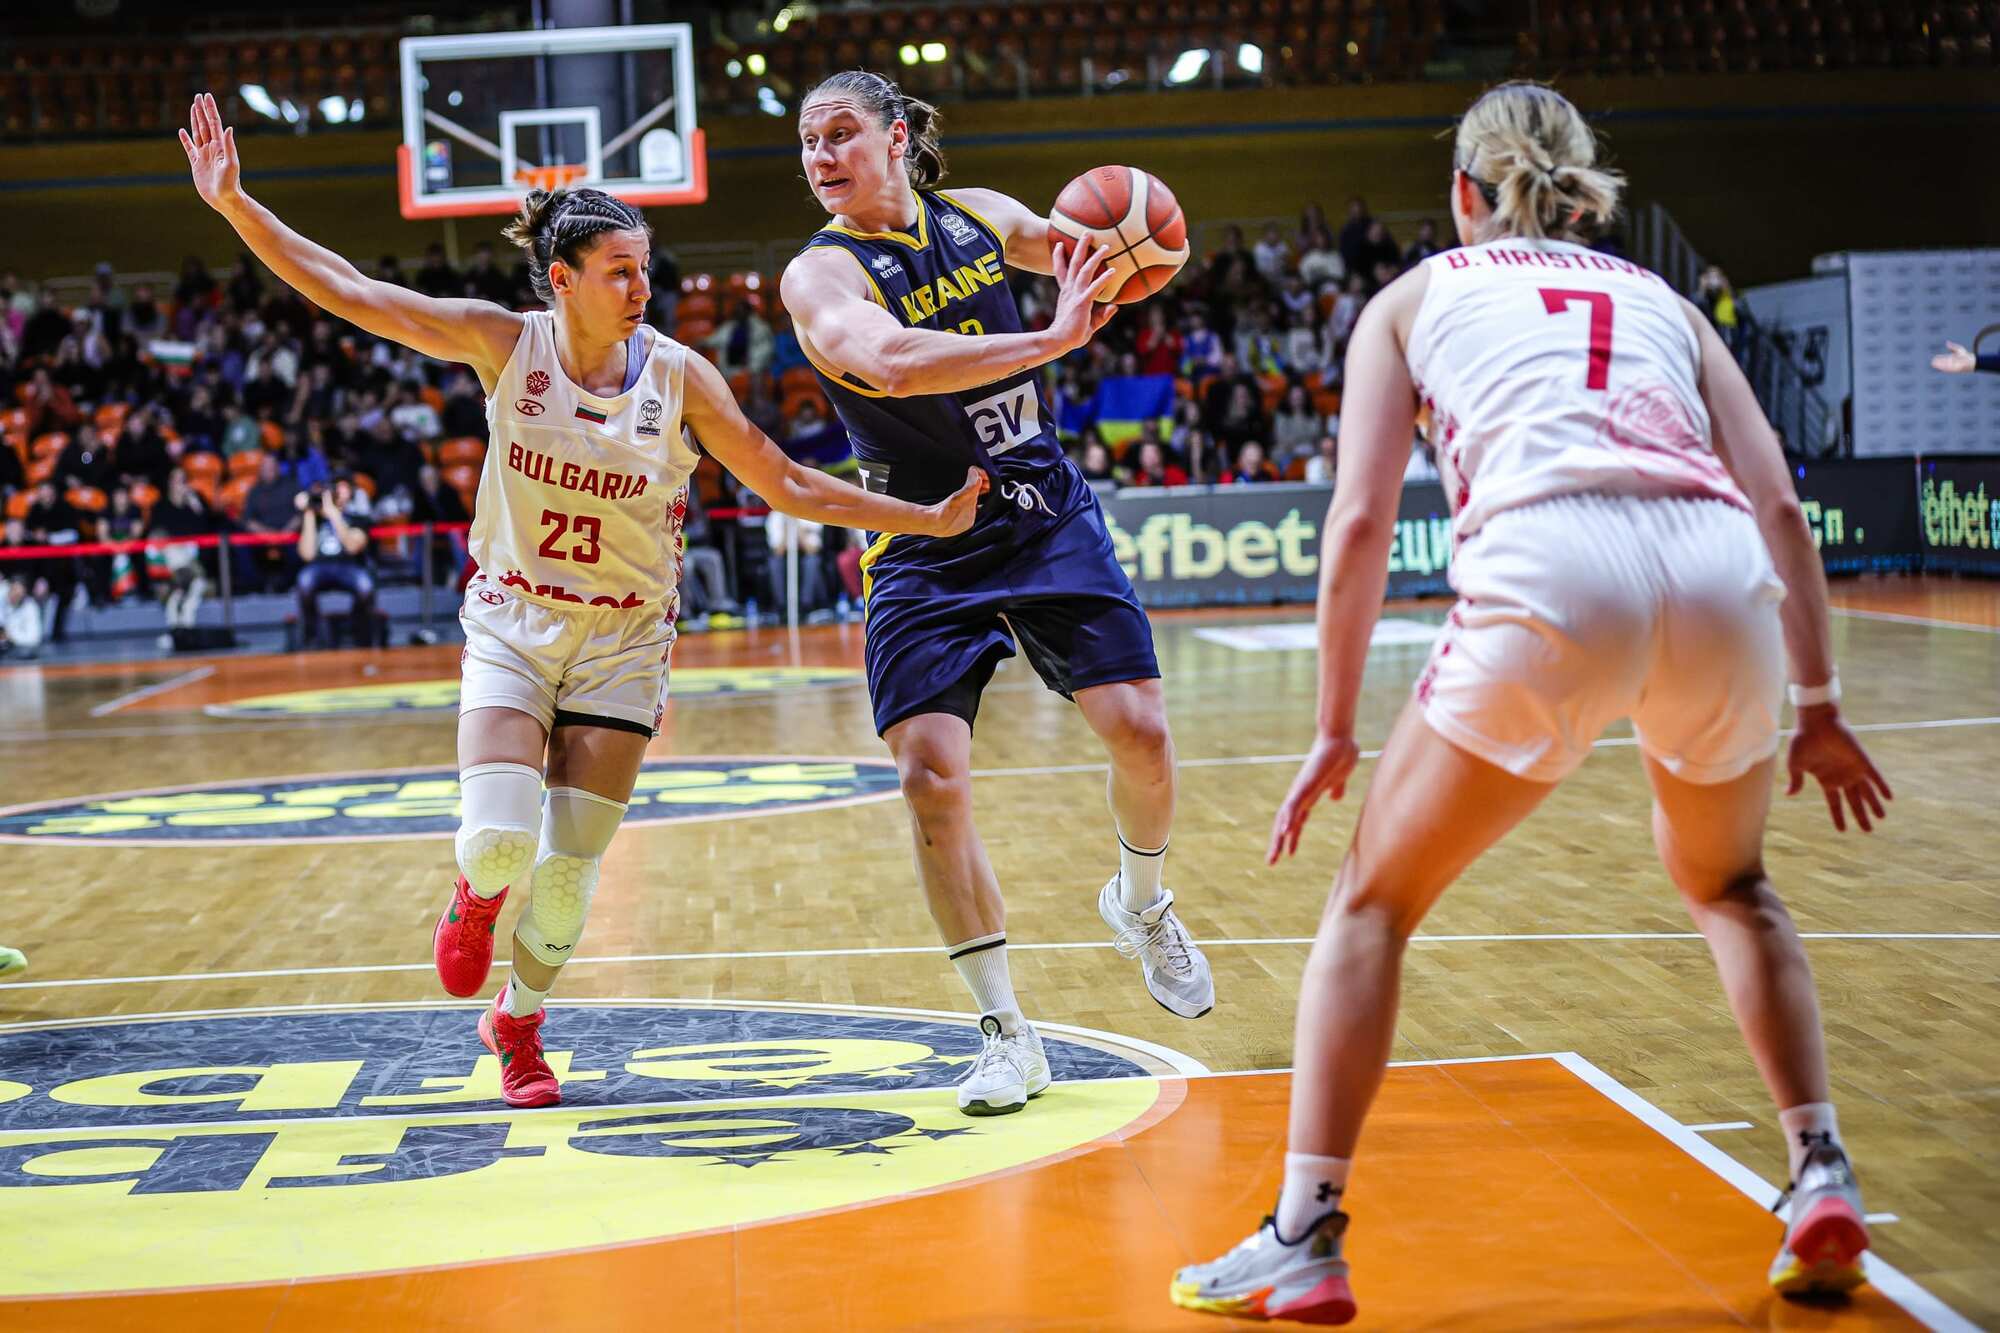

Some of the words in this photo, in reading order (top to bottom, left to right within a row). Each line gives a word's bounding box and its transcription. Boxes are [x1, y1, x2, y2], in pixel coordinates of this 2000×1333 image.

[1537, 287, 1614, 391] 7
[508, 441, 649, 500] BULGARIA
[538, 509, 602, 564] 23
